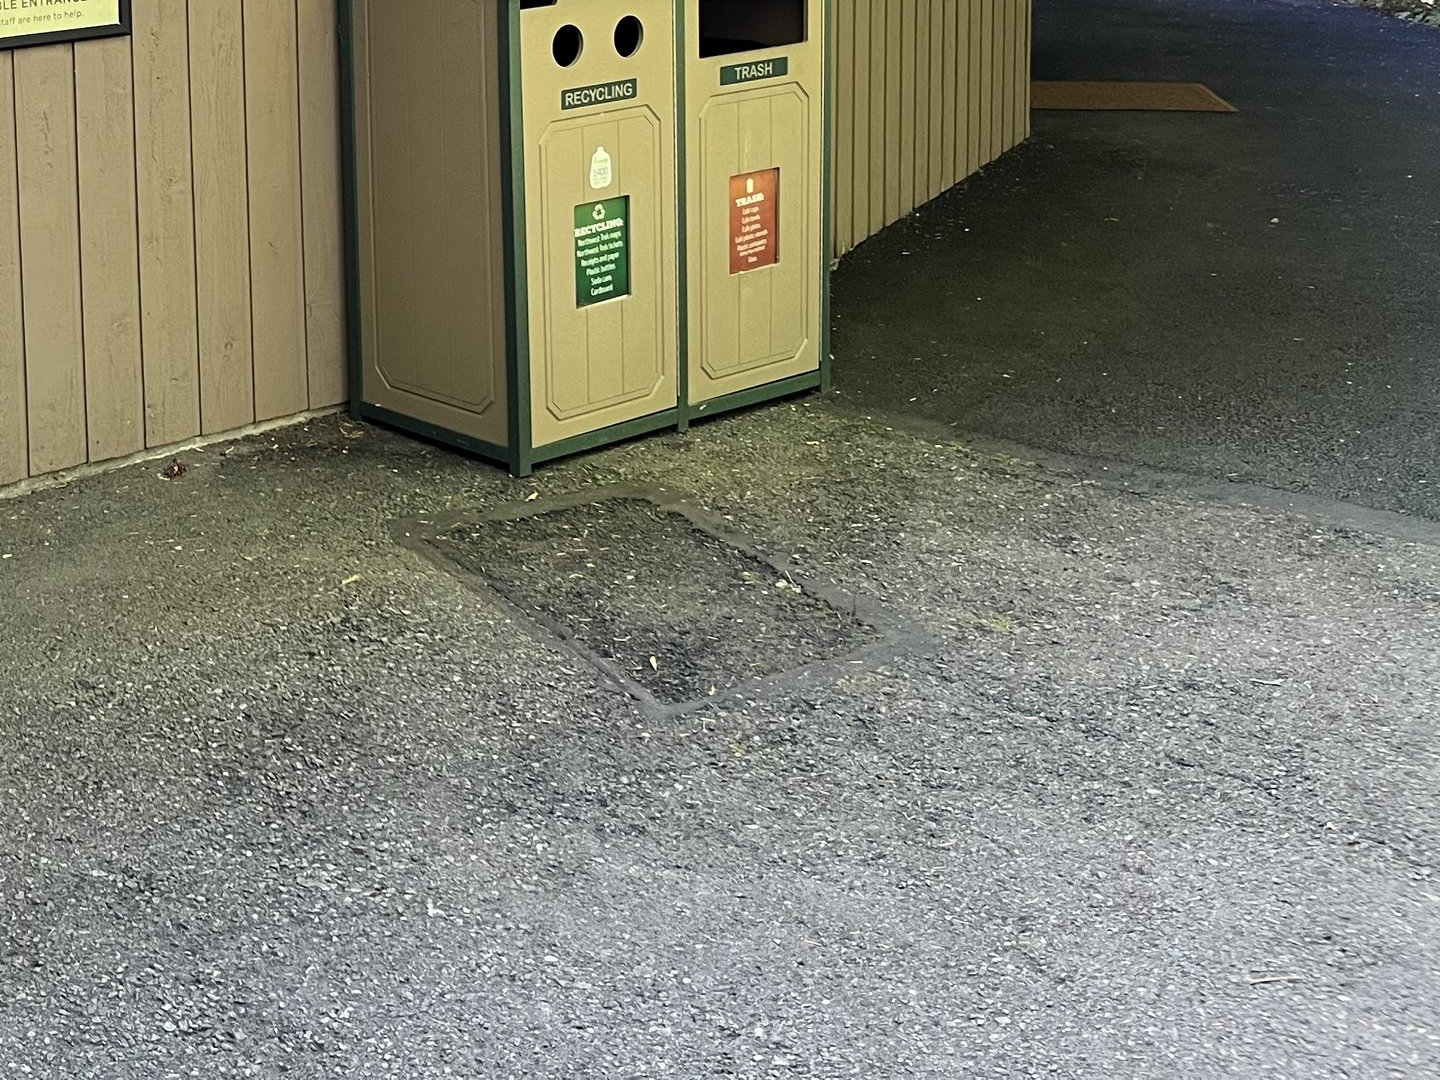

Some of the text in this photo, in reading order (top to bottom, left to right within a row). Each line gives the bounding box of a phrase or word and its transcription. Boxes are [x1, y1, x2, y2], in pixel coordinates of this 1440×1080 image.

[18, 16, 31, 24] are
[33, 13, 51, 23] here
[53, 12, 62, 20] to
[734, 62, 773, 80] TRASH
[565, 83, 633, 106] RECYCLING
